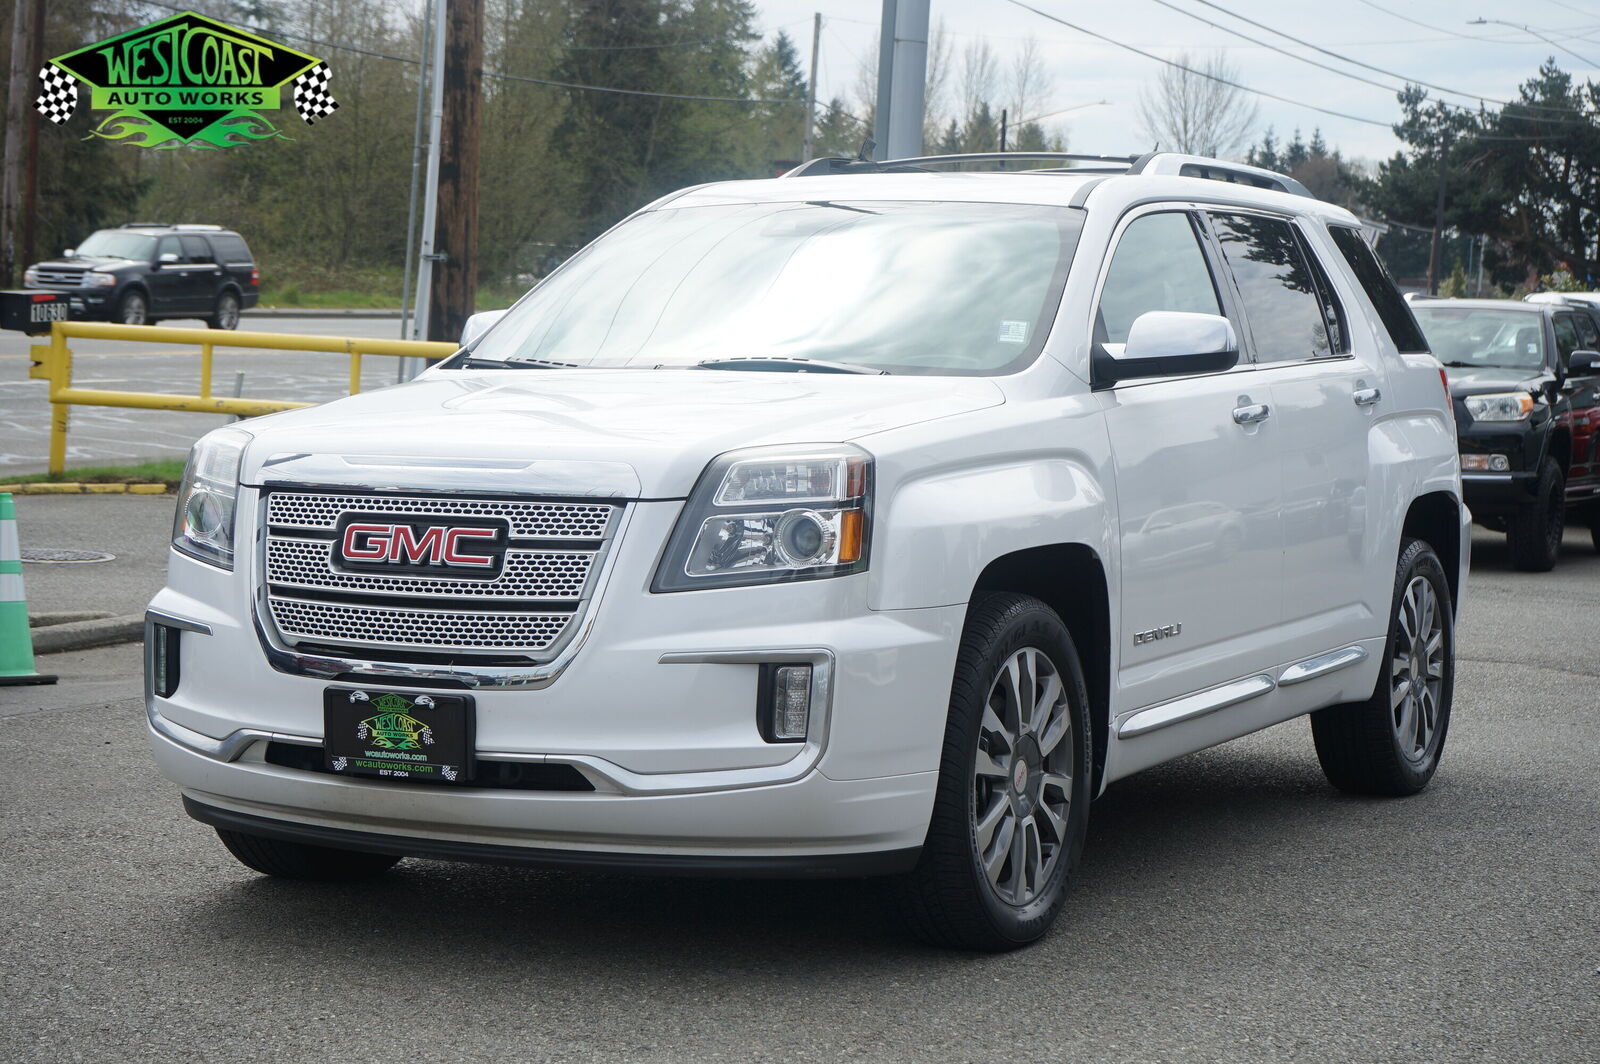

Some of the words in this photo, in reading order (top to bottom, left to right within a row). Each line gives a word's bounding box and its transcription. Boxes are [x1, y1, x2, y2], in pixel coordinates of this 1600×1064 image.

[342, 523, 498, 568] GMC
[1133, 622, 1182, 647] DENALI
[364, 750, 427, 761] wcautoworks.com
[356, 760, 433, 773] wcautoworks.com
